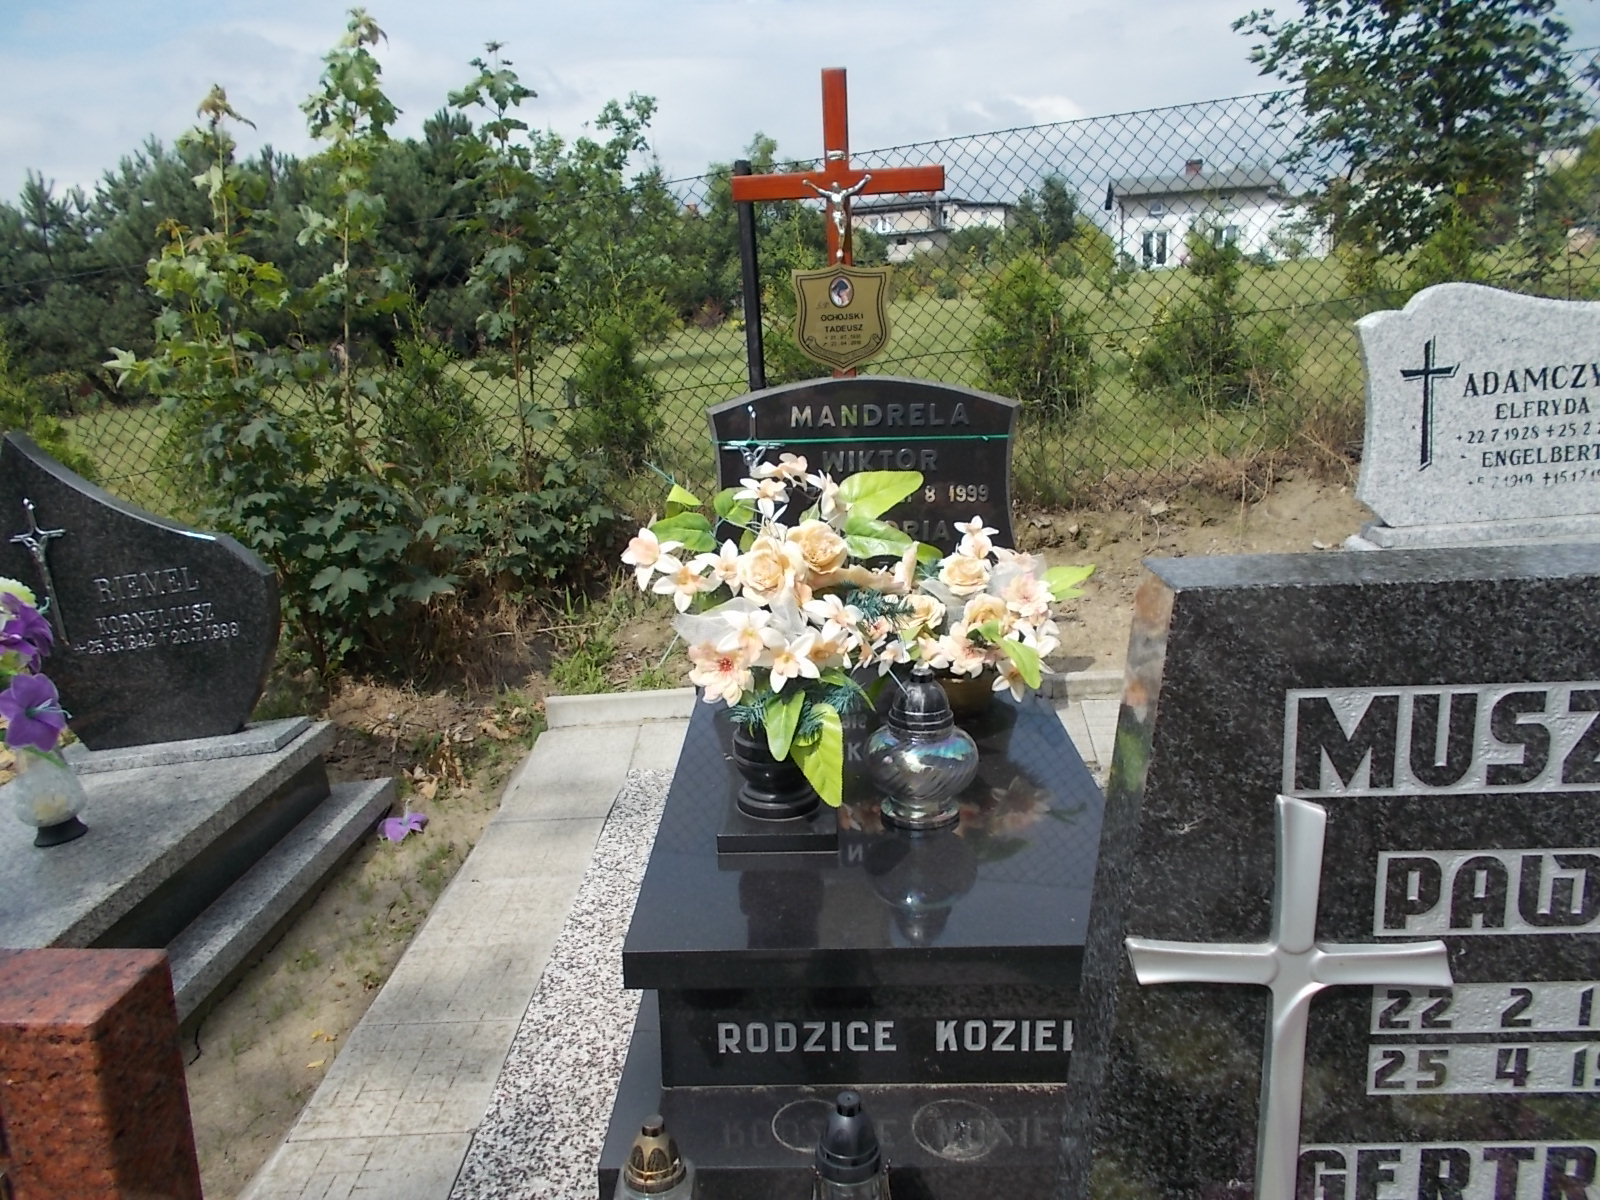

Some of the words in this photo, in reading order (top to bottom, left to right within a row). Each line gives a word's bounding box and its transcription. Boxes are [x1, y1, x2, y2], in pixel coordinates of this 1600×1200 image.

[825, 324, 863, 333] TADEUSZ
[790, 402, 970, 428] MANDRELA
[1495, 397, 1590, 420] ELFRYDA
[1467, 430, 1485, 444] 22
[1505, 425, 1539, 441] 1928
[1558, 423, 1577, 437] 25
[822, 448, 938, 473] WIKTOR
[924, 485, 936, 503] 8
[949, 484, 989, 503] 1999
[96, 602, 215, 635] KORNELIUSZ
[1293, 688, 1600, 792] MUSZ
[1379, 988, 1453, 1029] 22
[1501, 988, 1533, 1028] 2
[717, 1019, 898, 1054] RODZICE
[1375, 1050, 1449, 1089] 25
[1496, 1047, 1531, 1087] 4
